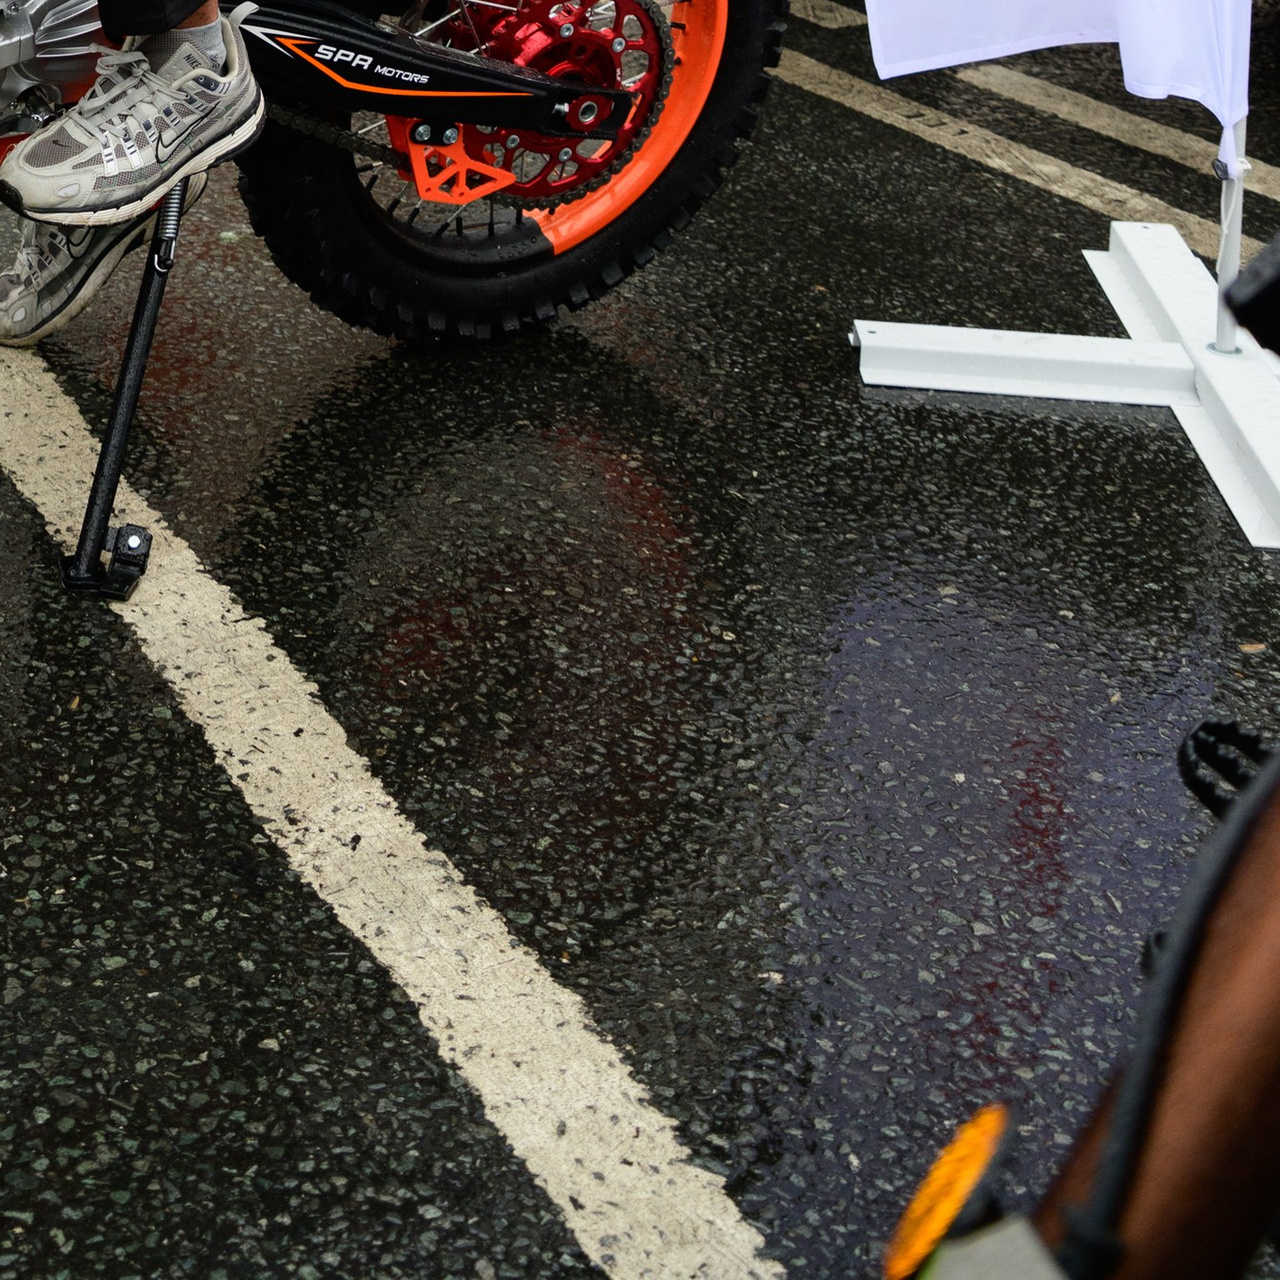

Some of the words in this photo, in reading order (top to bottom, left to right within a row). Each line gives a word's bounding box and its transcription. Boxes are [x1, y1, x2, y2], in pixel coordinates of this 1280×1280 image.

[182, 53, 202, 70] NIKE
[314, 43, 373, 71] SPR
[374, 64, 430, 84] MOTORS
